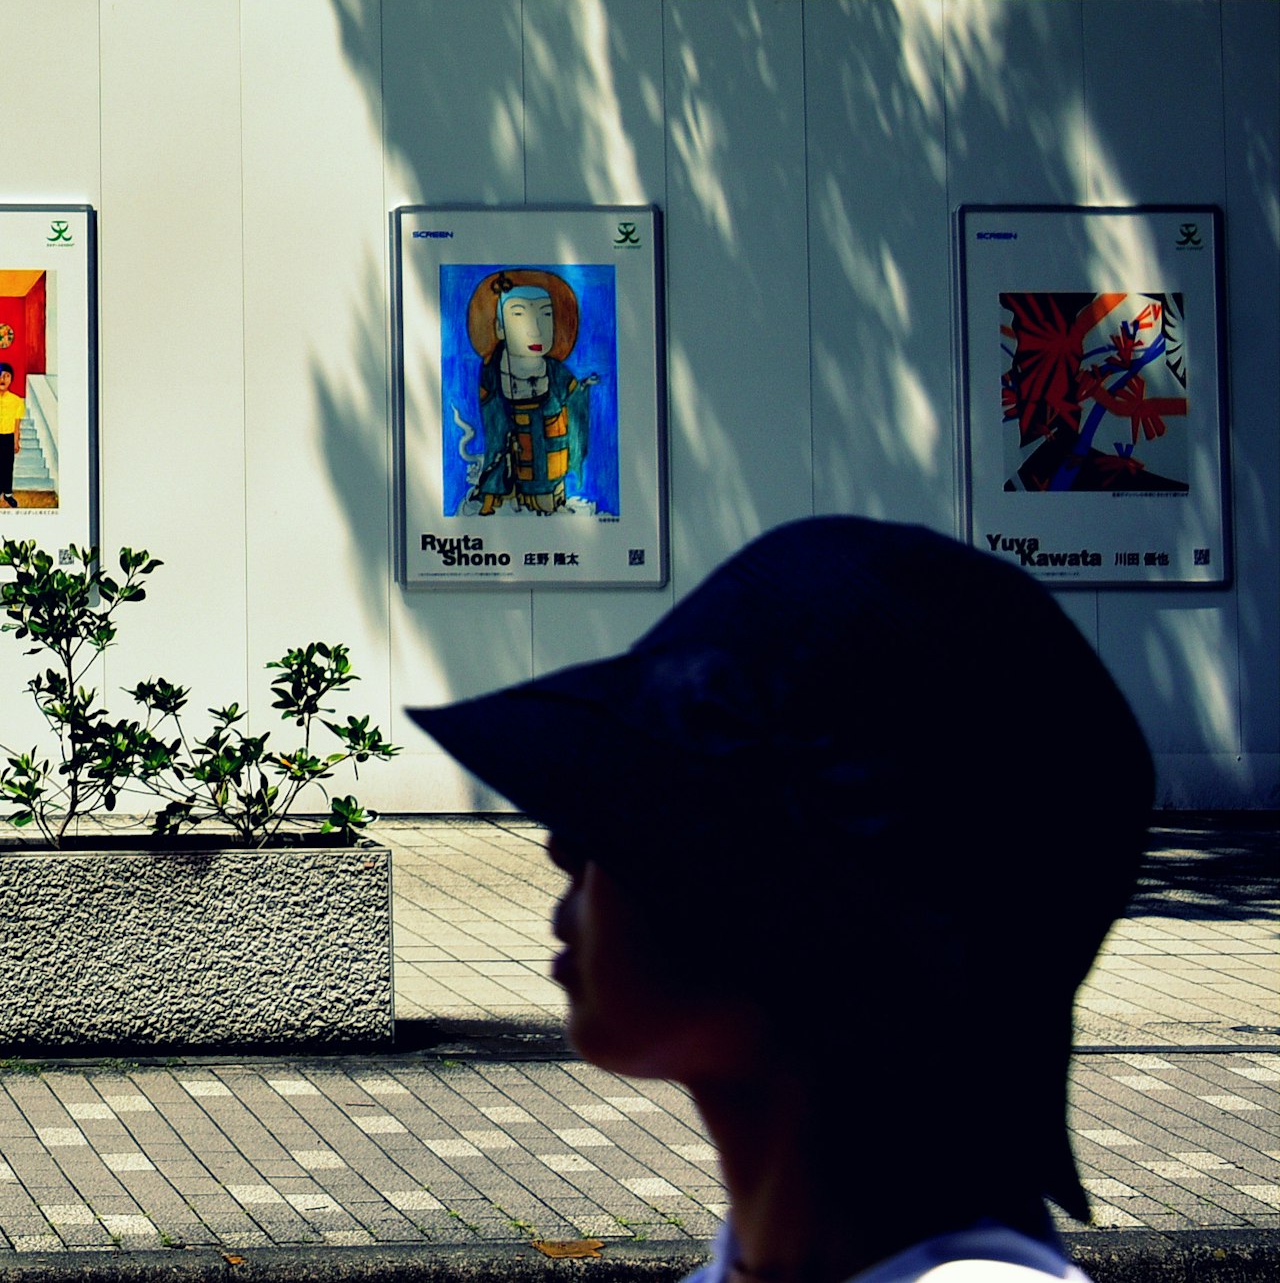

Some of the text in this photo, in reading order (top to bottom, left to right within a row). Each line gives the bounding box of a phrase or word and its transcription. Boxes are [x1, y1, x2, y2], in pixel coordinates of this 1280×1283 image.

[412, 230, 454, 239] SCREEN
[421, 534, 483, 553] Ryuta
[986, 534, 1040, 554] Yuya
[442, 550, 511, 566] Shono
[1020, 549, 1103, 567] Kawata
[1114, 552, 1140, 566] 川田
